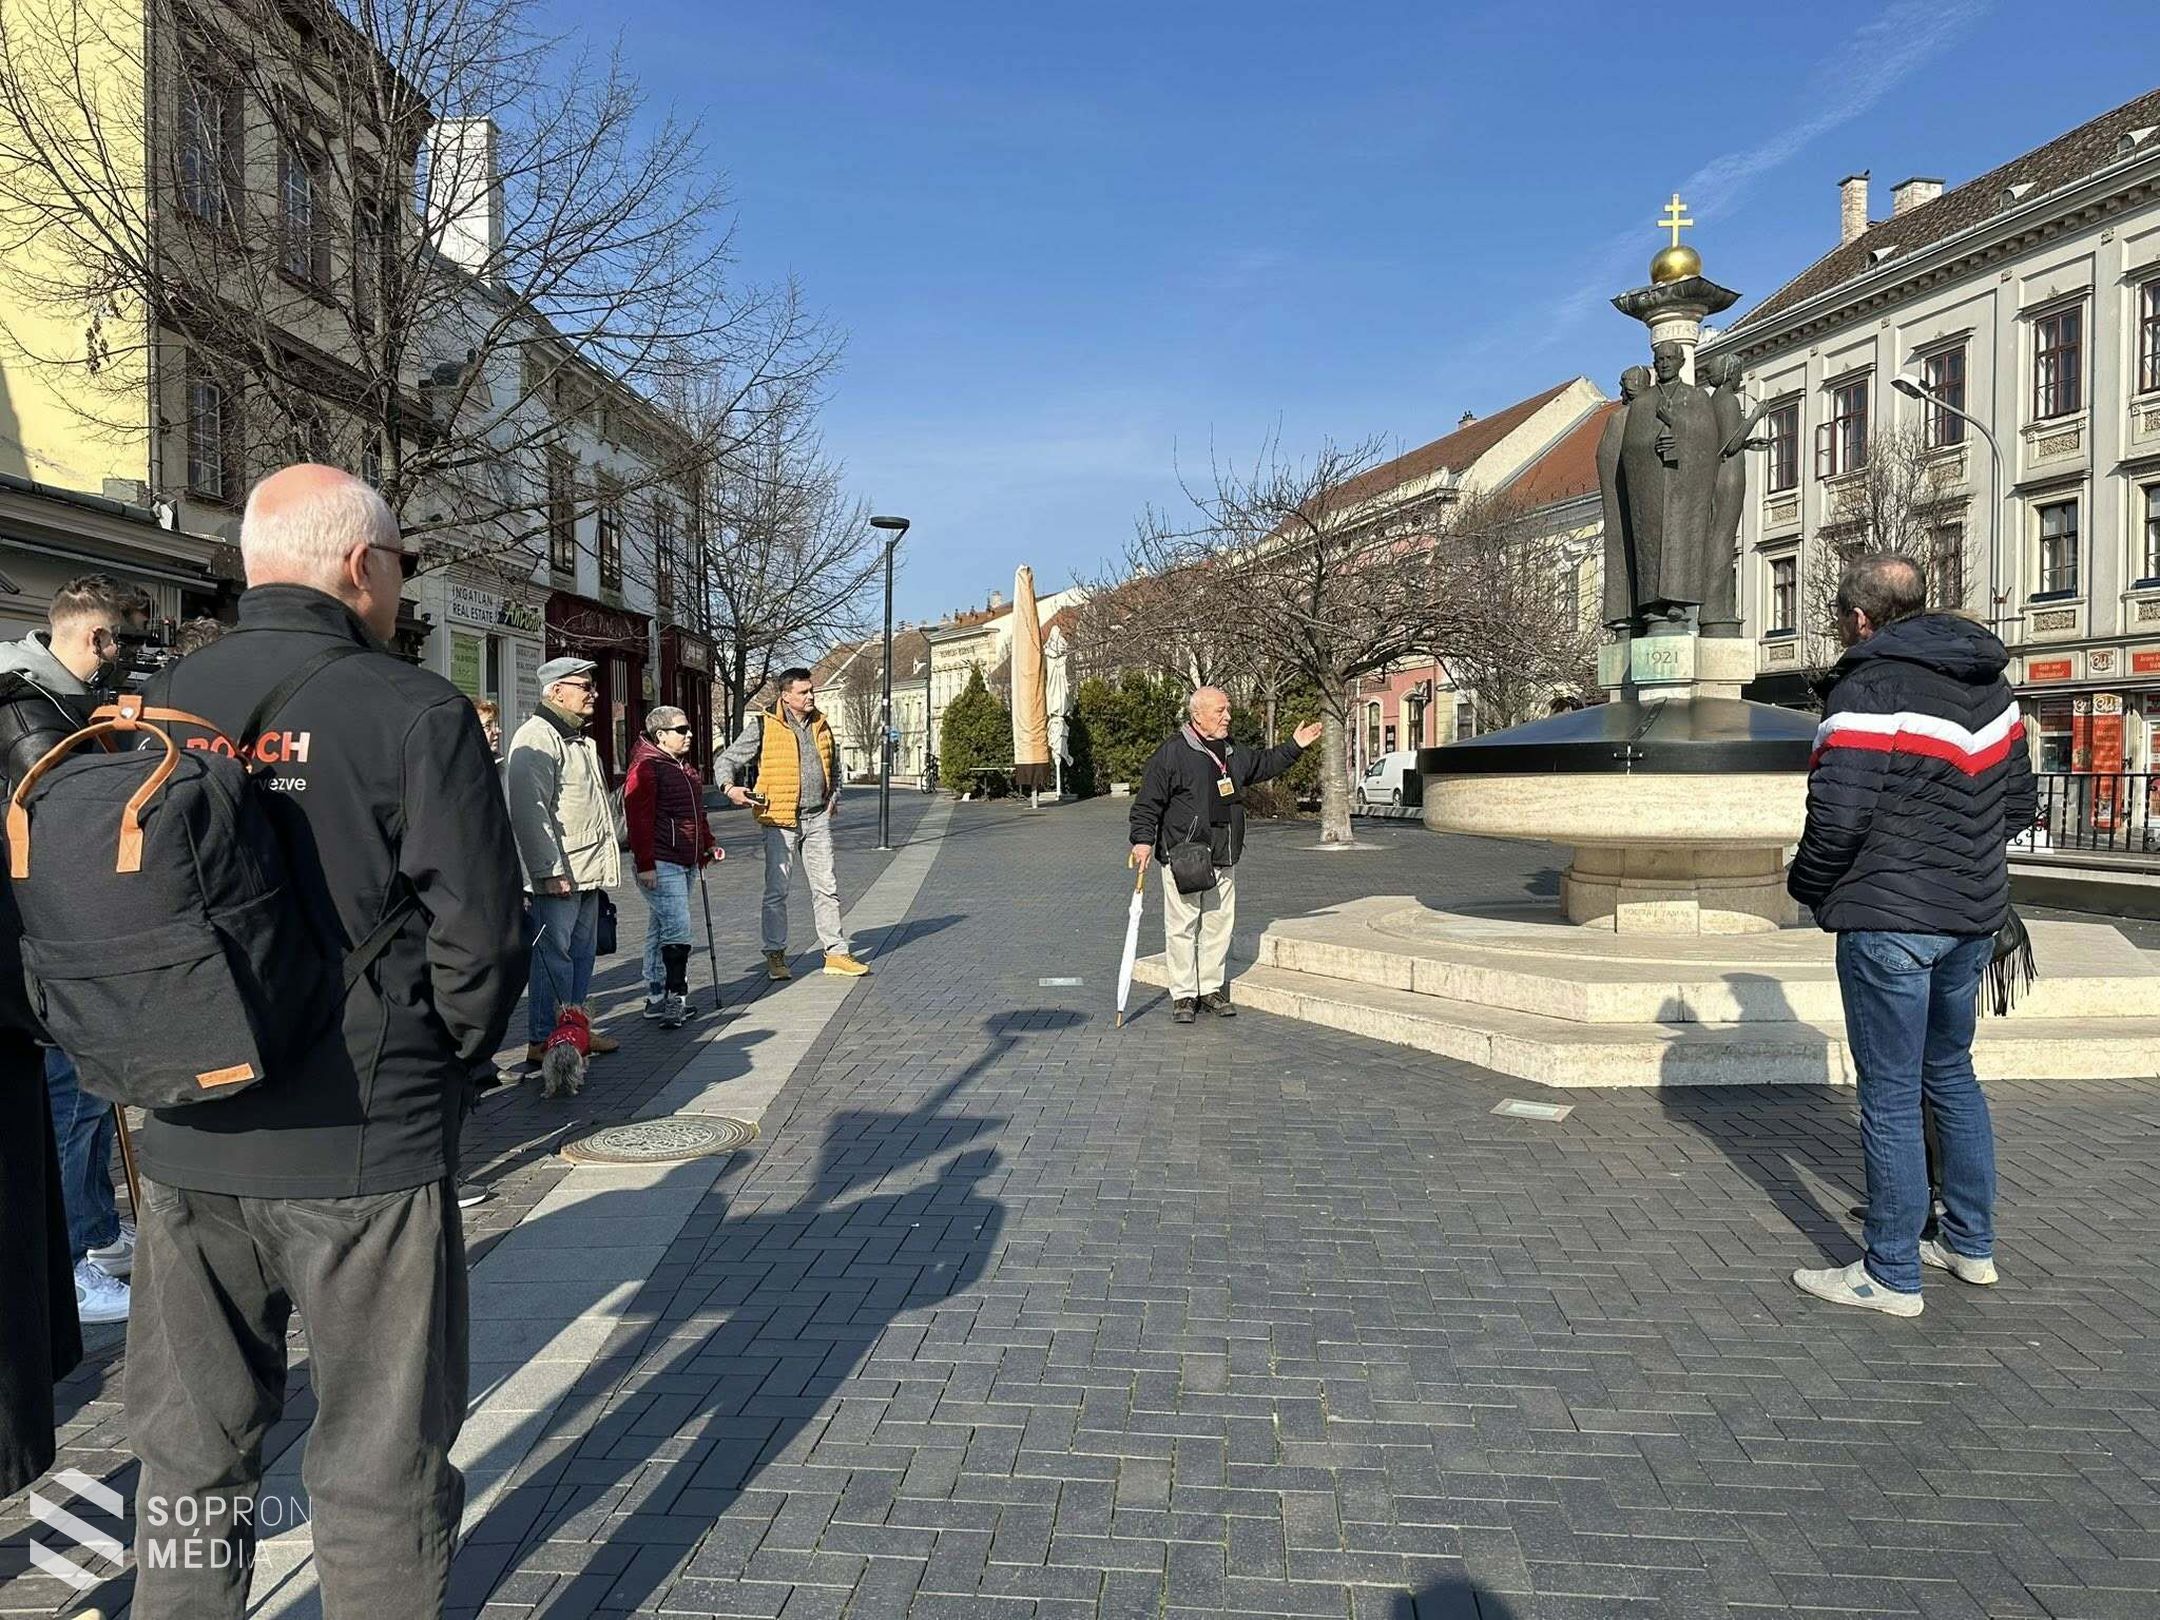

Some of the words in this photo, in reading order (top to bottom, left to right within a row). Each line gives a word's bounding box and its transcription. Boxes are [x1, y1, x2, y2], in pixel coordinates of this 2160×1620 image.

[452, 585, 493, 606] INGATLAN
[453, 603, 469, 618] REAL
[471, 607, 493, 623] ESTATE
[1646, 651, 1679, 664] 1921
[186, 731, 311, 763] OCH
[258, 778, 307, 791] vezve
